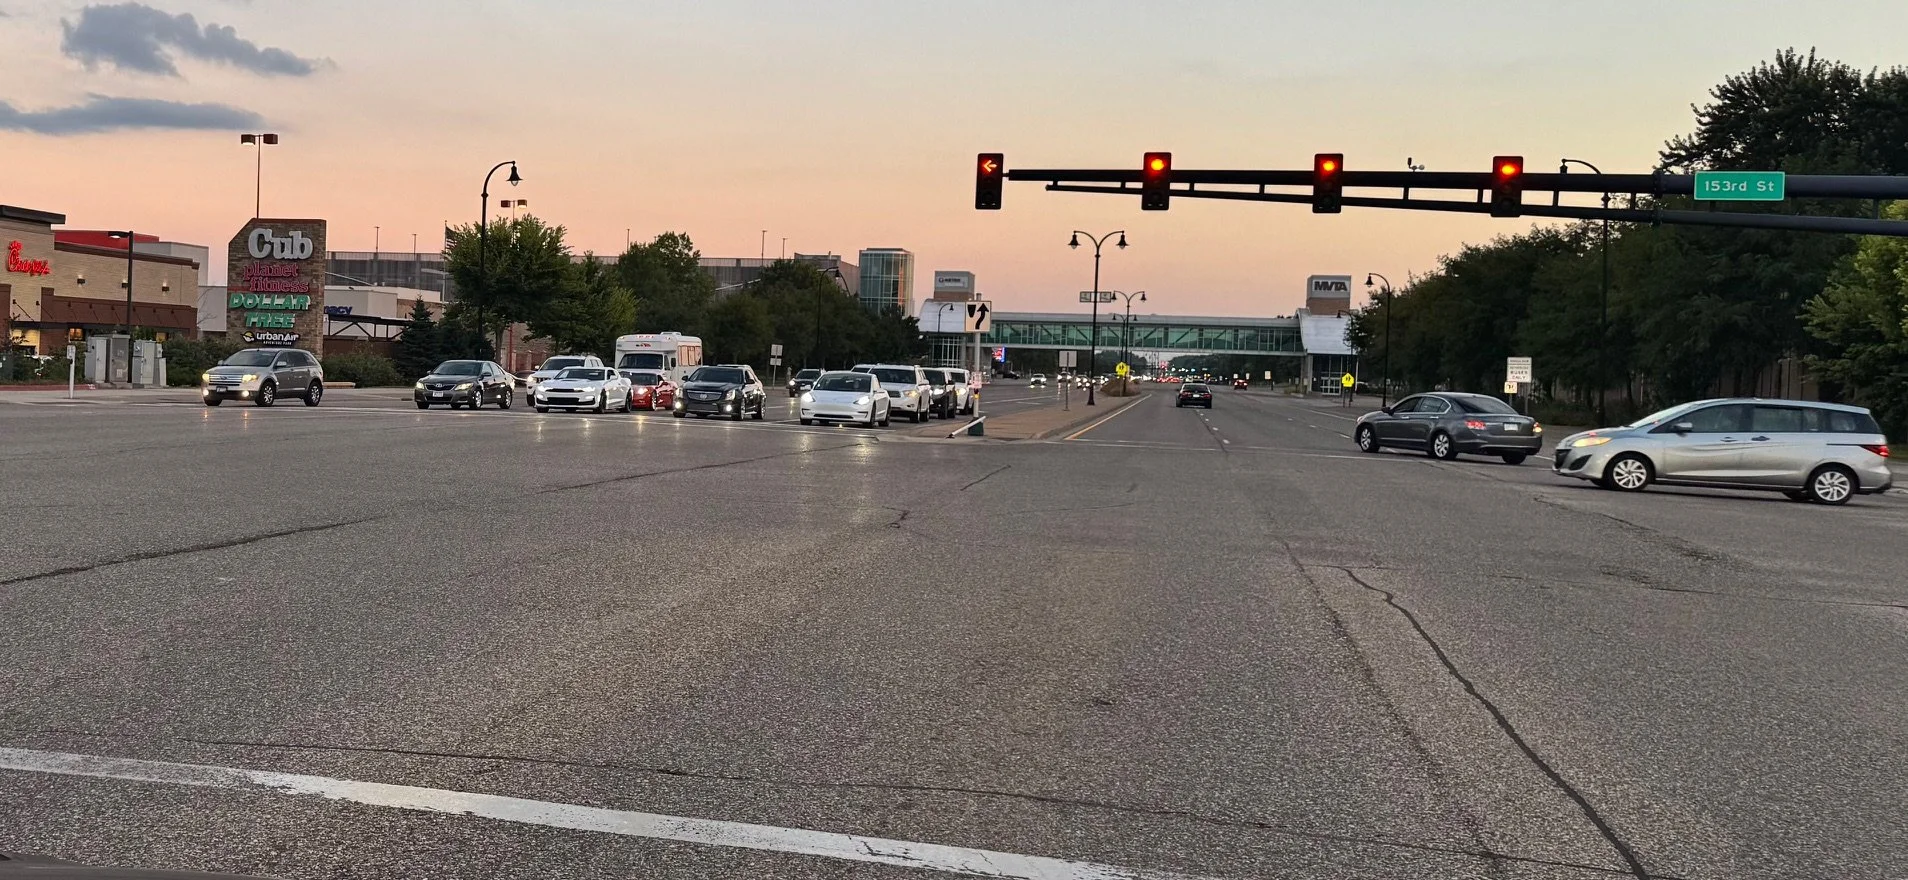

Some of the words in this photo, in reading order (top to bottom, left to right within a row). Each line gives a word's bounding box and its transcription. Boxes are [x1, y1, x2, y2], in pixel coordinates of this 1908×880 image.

[1705, 180, 1747, 191] 153rd
[1756, 180, 1775, 191] St
[248, 228, 313, 259] Cub
[244, 262, 299, 281] planet
[249, 277, 309, 292] fitness
[1314, 281, 1348, 291] MVTA
[228, 292, 311, 311] DOLLAR
[245, 311, 296, 329] TREE
